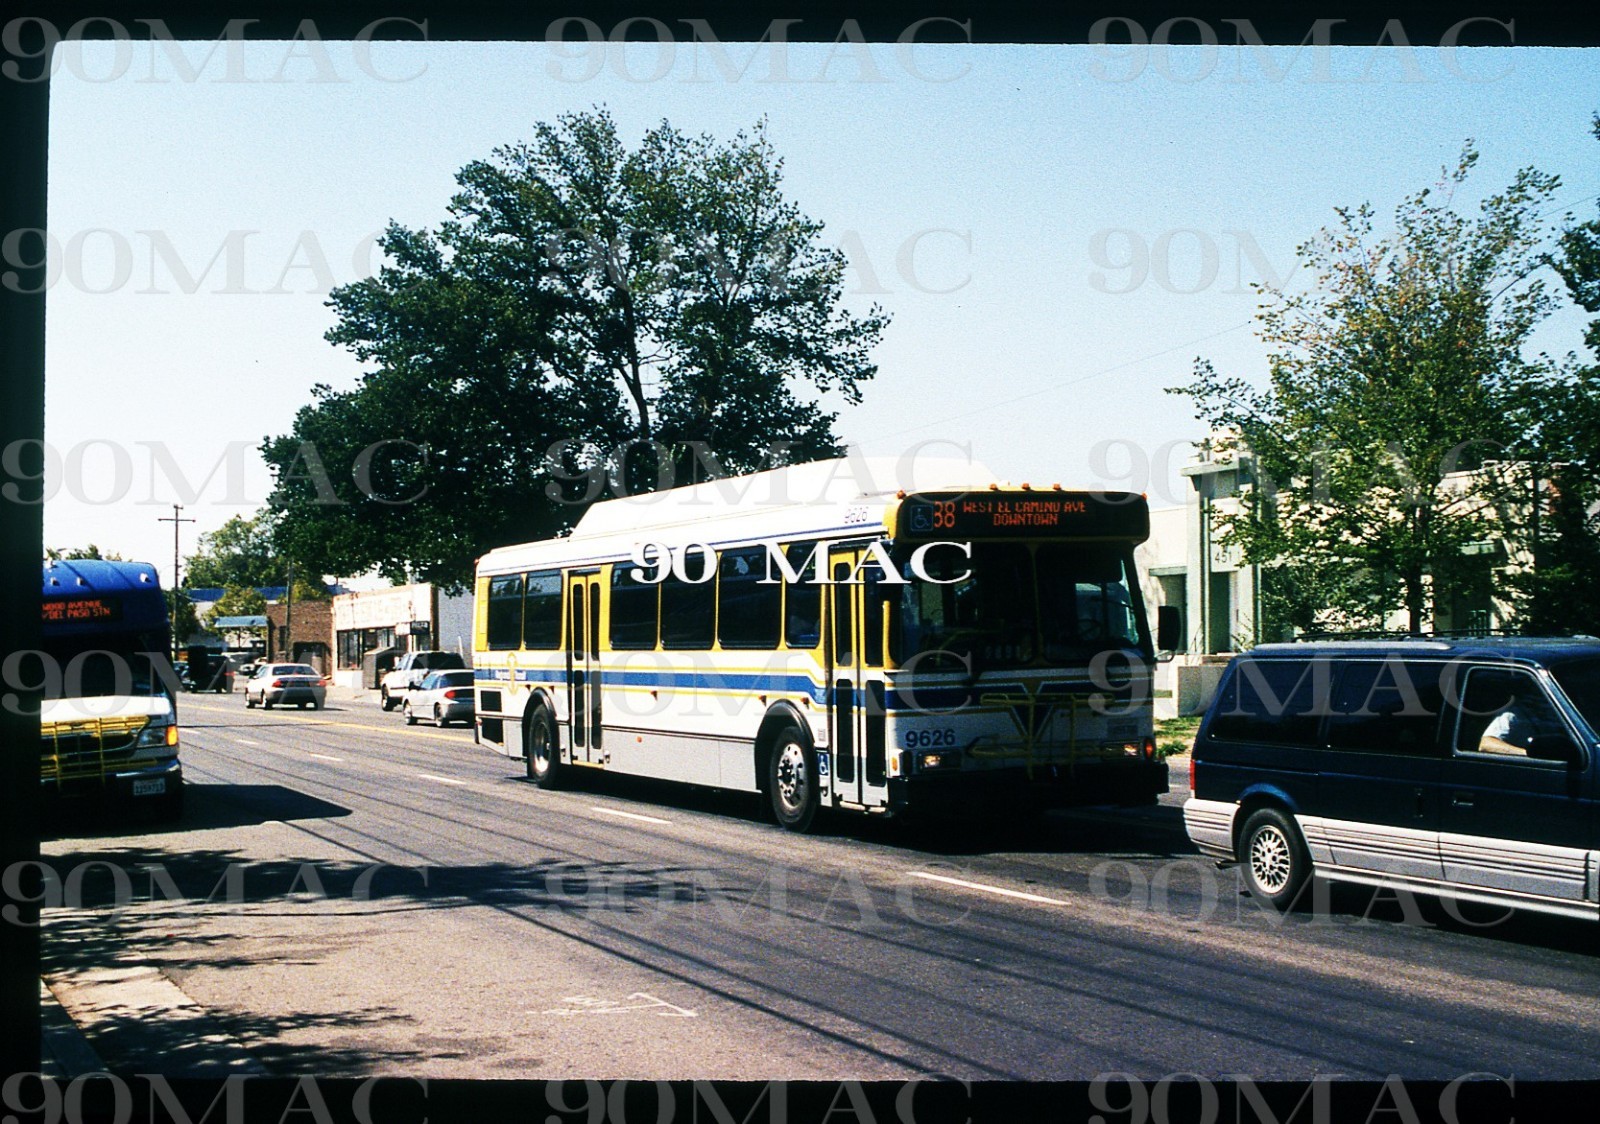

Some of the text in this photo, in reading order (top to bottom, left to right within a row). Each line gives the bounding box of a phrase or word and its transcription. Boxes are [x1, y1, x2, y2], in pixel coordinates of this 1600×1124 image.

[962, 501, 1087, 513] WEST EL CAMINO AVE
[844, 506, 869, 524] 9626
[993, 513, 1059, 526] DOWNTOWN
[67, 608, 90, 618] PASO
[905, 728, 956, 748] 9626
